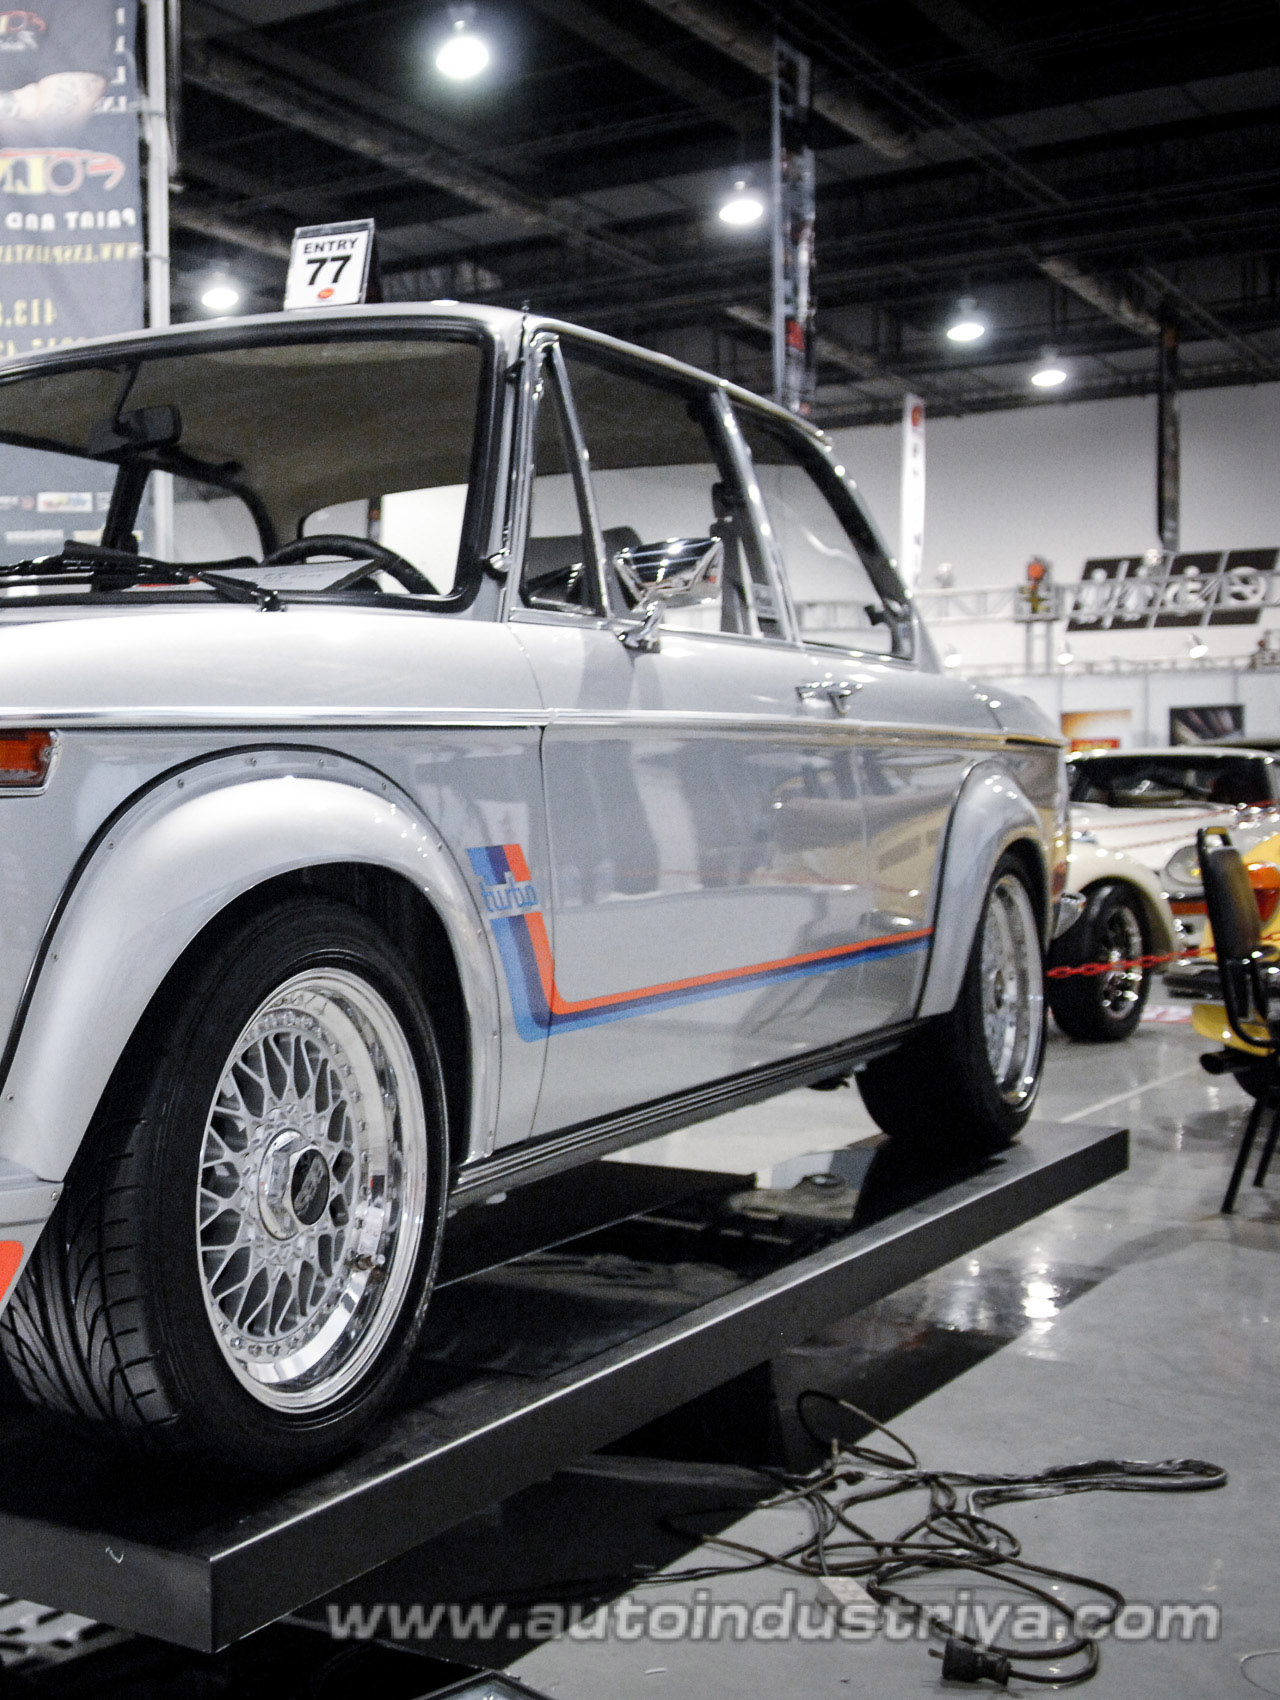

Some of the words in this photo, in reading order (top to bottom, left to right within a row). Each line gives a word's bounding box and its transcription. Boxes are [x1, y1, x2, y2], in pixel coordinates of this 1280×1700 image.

[303, 237, 360, 254] ENTRY
[306, 254, 353, 286] 77
[478, 872, 539, 913] turbo
